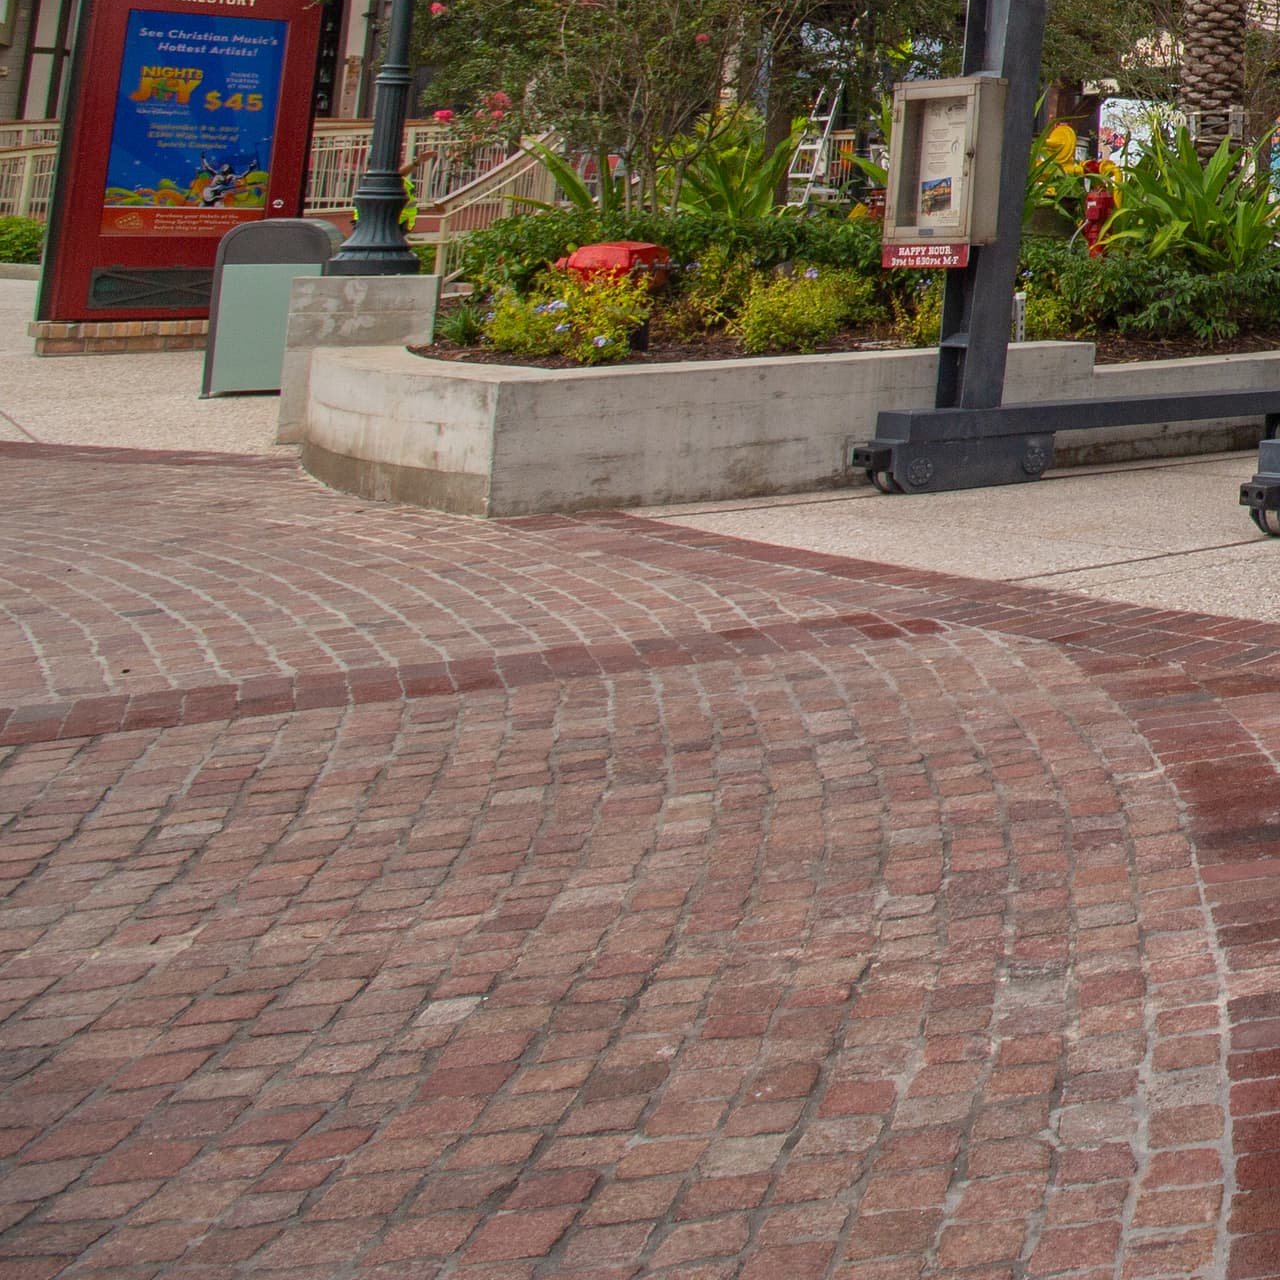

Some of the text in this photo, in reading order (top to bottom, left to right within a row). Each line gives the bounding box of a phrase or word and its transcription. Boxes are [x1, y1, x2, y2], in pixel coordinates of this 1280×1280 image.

[139, 27, 279, 46] See Christian Music's
[157, 42, 259, 57] Hottest Artists!
[204, 89, 264, 112] $45
[898, 246, 927, 256] HAPPY
